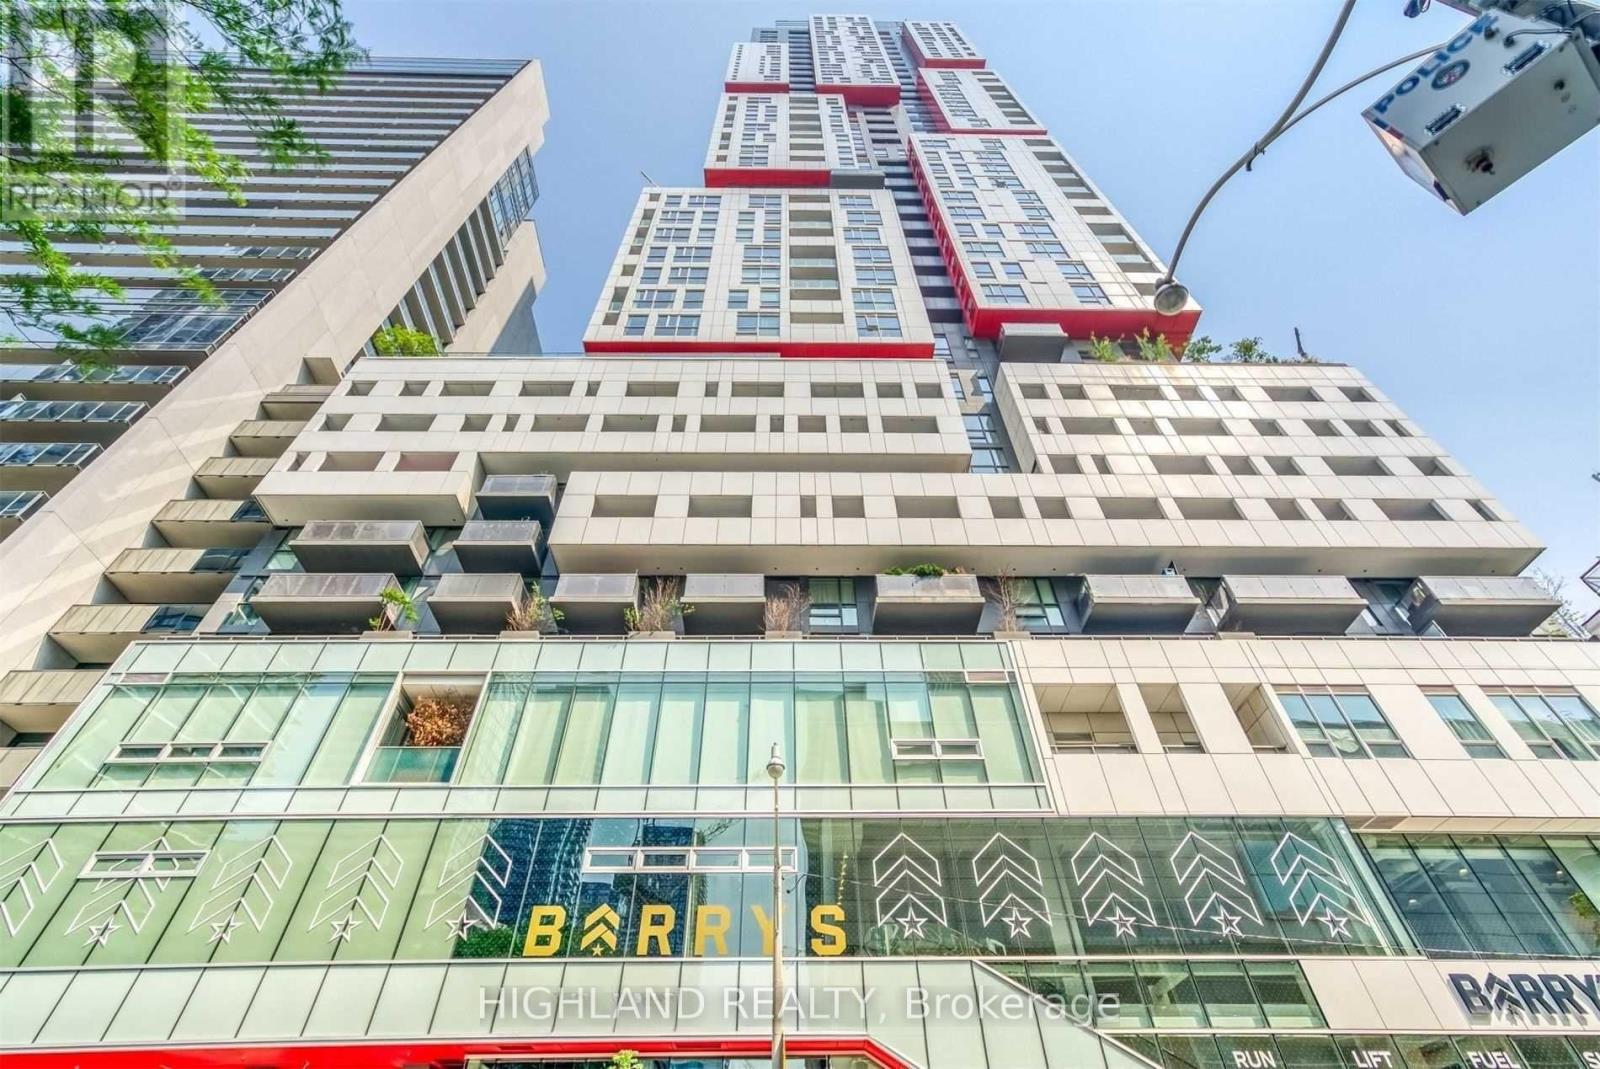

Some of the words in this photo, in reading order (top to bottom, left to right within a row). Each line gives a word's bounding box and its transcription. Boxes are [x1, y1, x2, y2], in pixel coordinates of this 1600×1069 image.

[1373, 14, 1499, 114] POLICE
[1232, 1050, 1277, 1069] RUN
[1351, 1050, 1393, 1069] LIFT
[1467, 1050, 1522, 1069] FUEL
